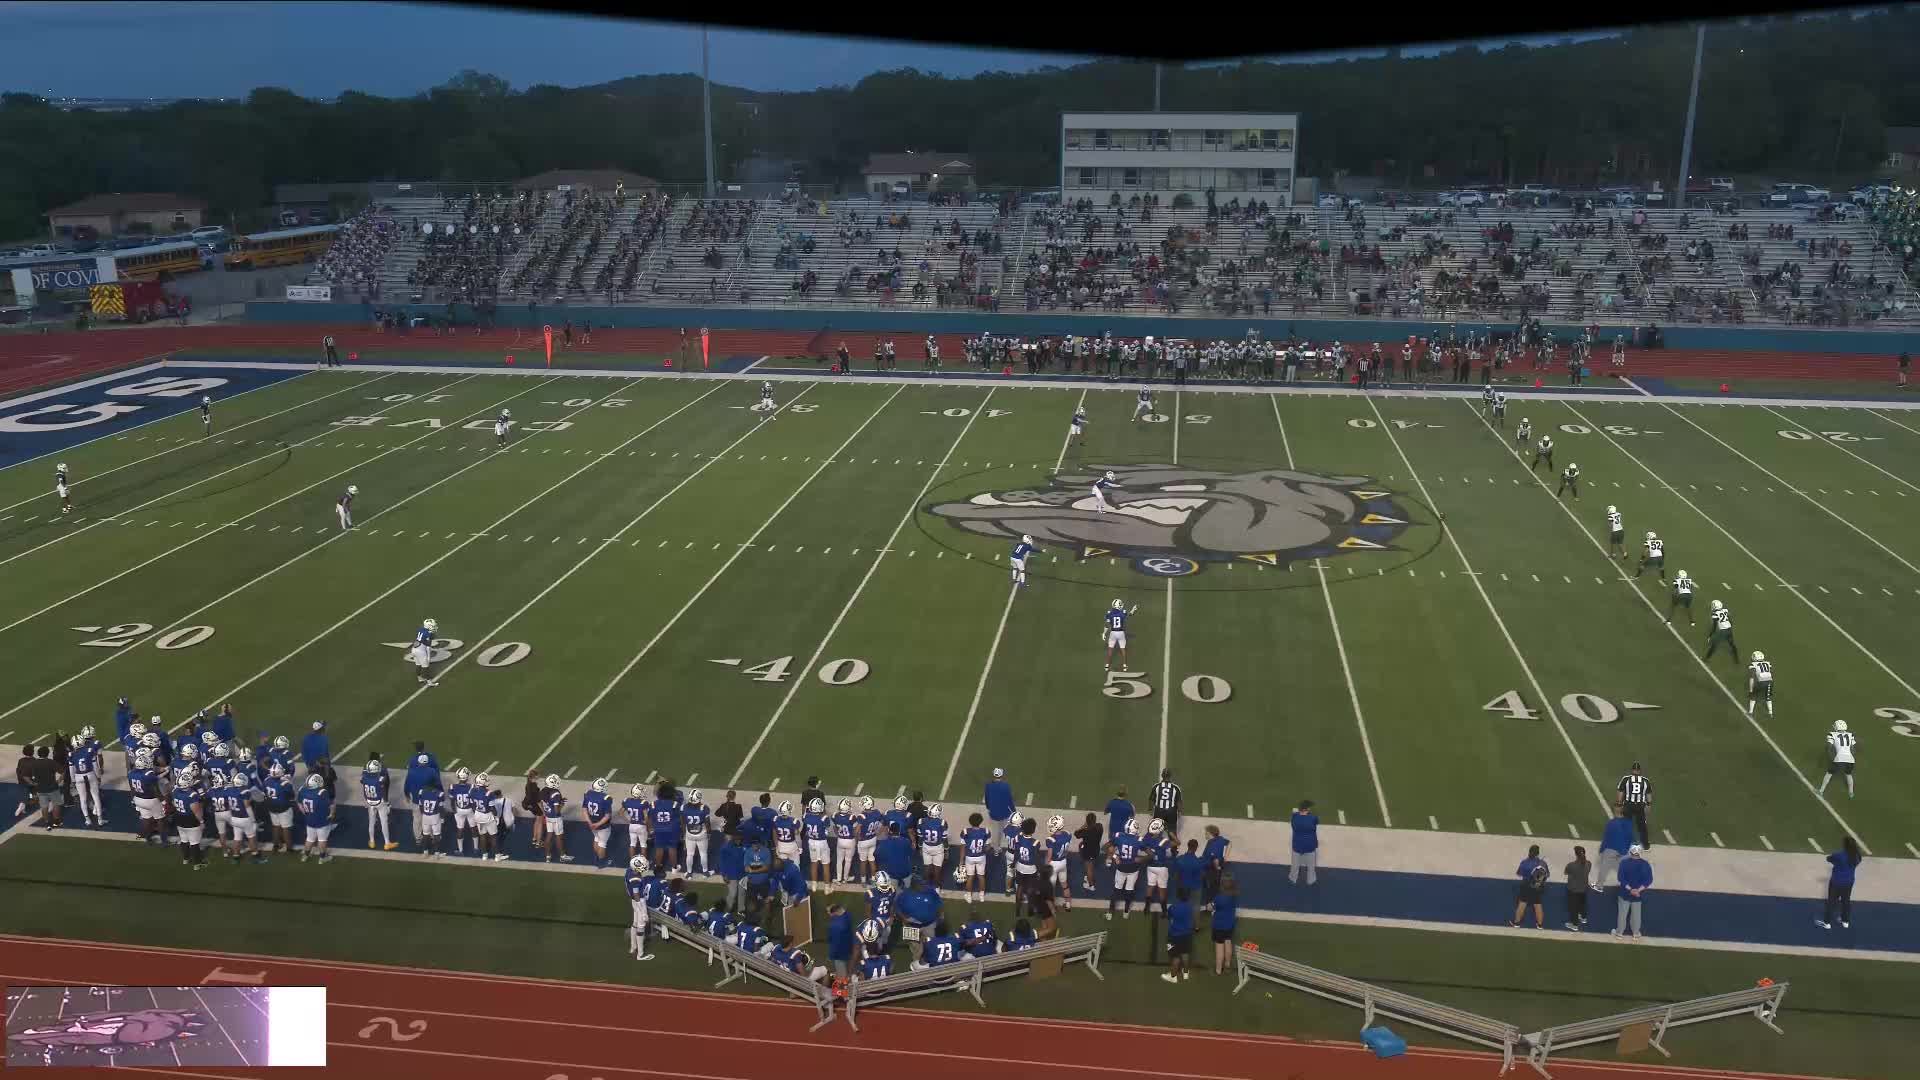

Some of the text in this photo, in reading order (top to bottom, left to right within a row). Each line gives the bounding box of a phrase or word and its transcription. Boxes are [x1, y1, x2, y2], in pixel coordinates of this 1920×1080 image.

[1650, 541, 1662, 550] 52
[1679, 579, 1691, 590] 45
[1113, 616, 1122, 629] 13
[79, 623, 216, 650] 20
[742, 656, 871, 686] 40
[1758, 662, 1770, 673] 10
[1101, 671, 1233, 703] 50
[1483, 690, 1619, 723] 40
[1836, 733, 1851, 747] 11
[1161, 788, 1171, 800] S
[1631, 782, 1641, 795] B
[936, 942, 953, 963] 73
